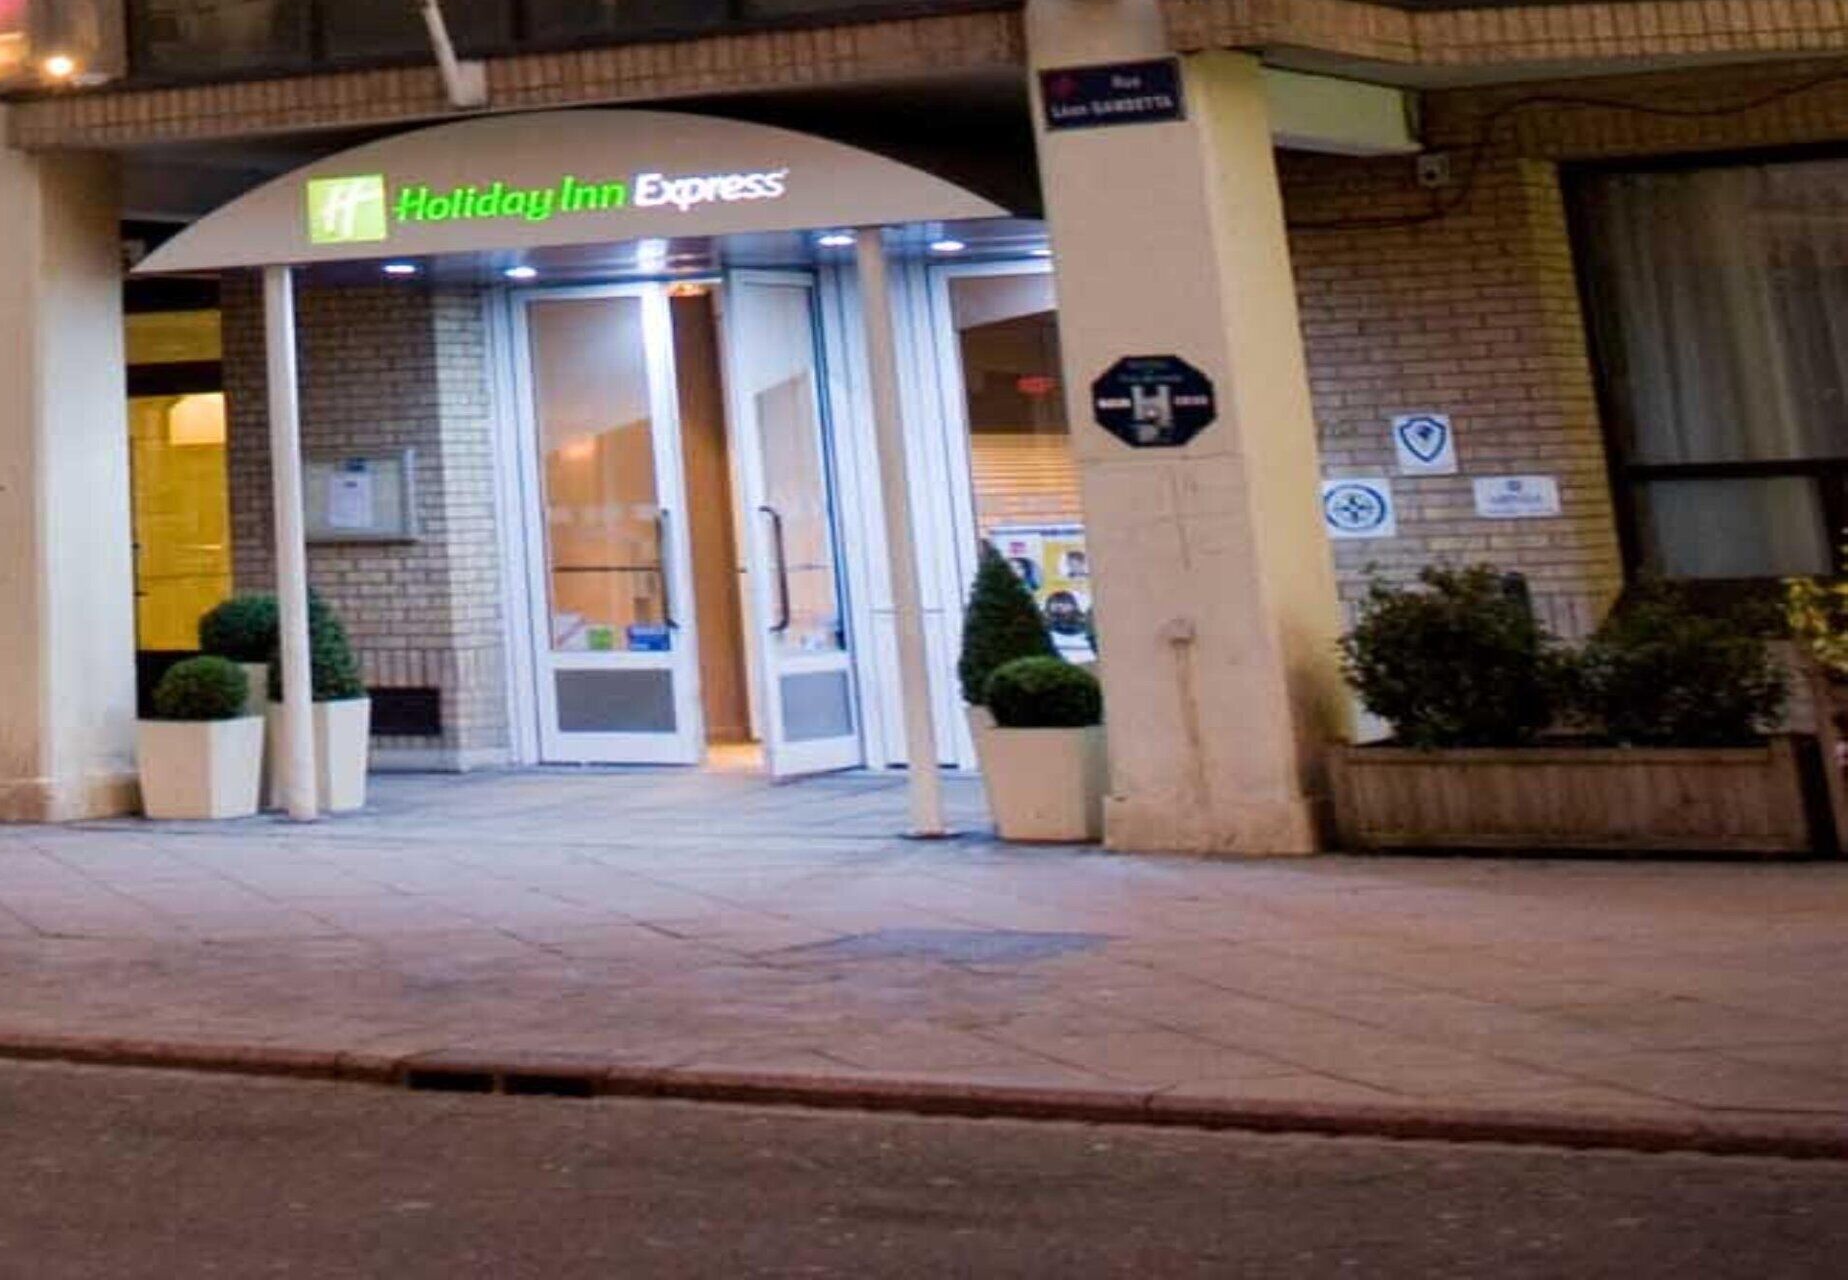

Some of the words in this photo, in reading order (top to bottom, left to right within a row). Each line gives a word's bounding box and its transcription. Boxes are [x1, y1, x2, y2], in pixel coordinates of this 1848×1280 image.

[395, 180, 554, 222] Holiday
[561, 175, 626, 212] Inn
[634, 170, 789, 211] Express
